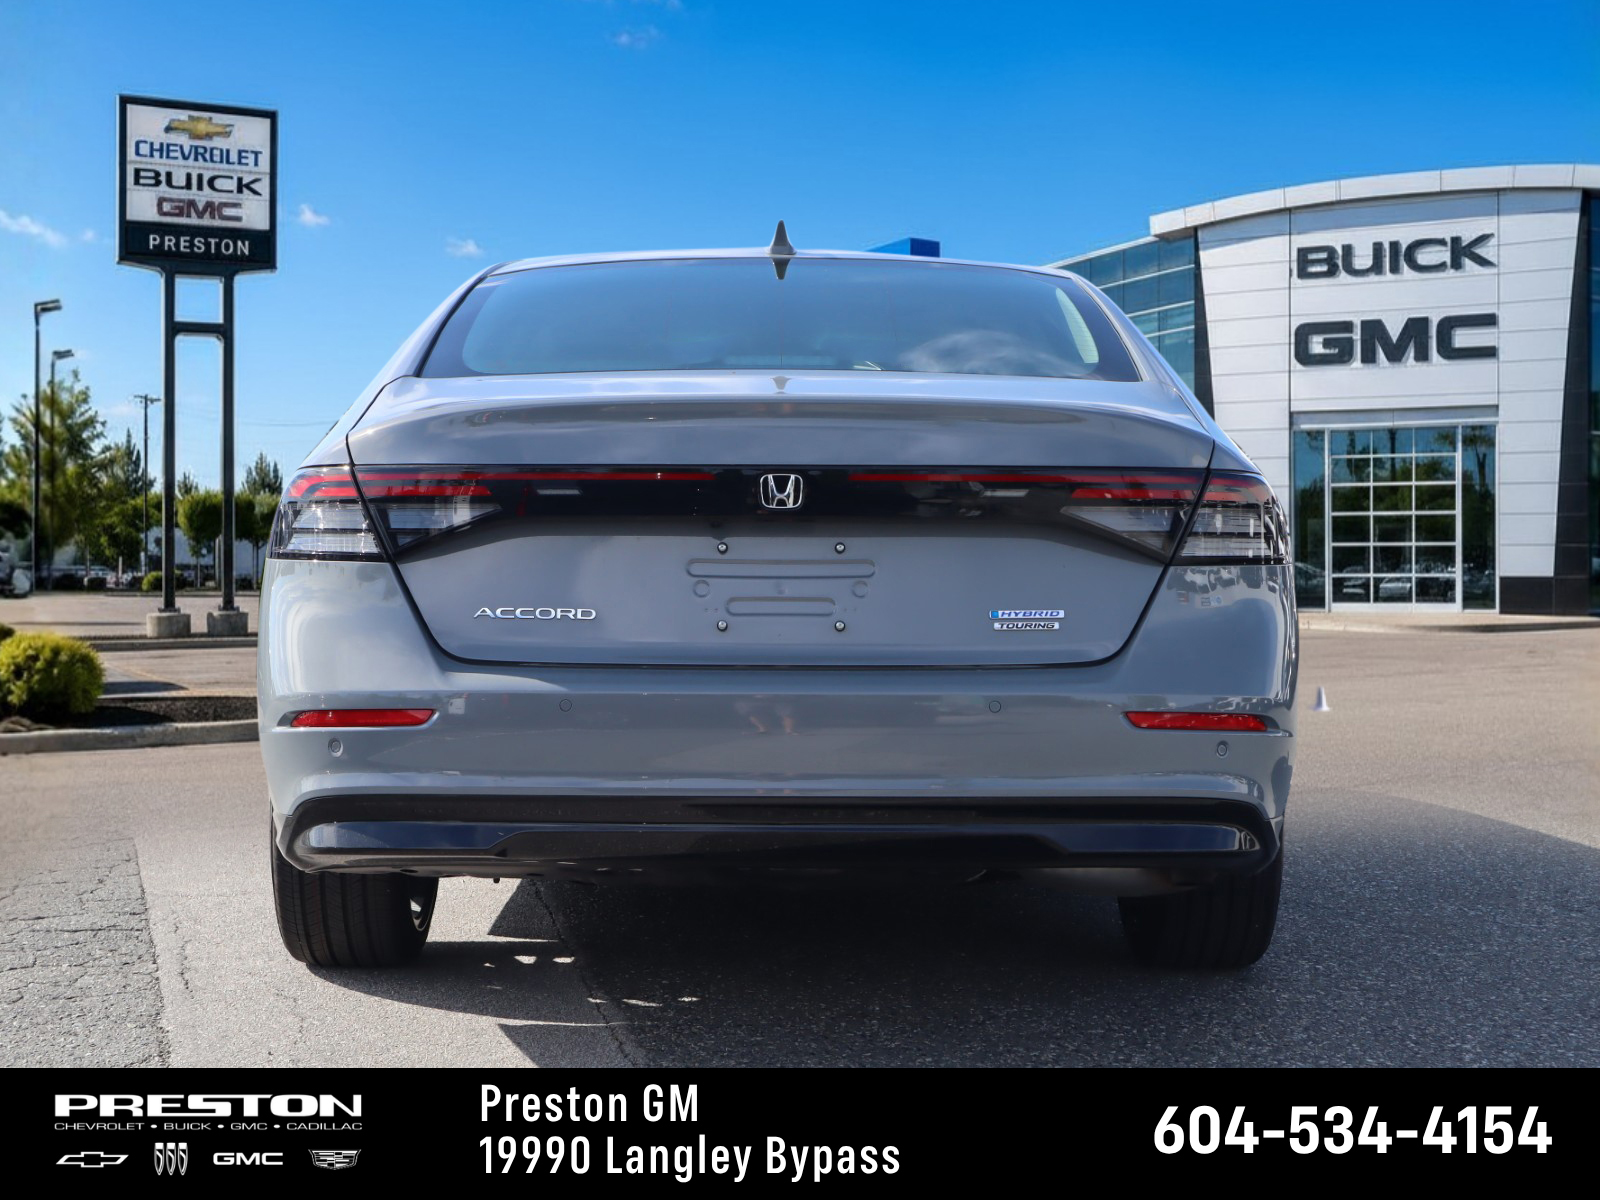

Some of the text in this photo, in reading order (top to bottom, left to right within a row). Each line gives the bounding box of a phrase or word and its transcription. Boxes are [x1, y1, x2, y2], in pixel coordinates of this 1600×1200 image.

[134, 140, 263, 167] CHEVROLET
[133, 167, 262, 197] BUICK
[156, 196, 243, 222] GMC
[149, 234, 250, 257] PRESTON
[1296, 233, 1497, 280] BUICK
[1294, 313, 1498, 367] GMC
[473, 607, 597, 620] ACCORD
[1000, 610, 1060, 618] HYBRID
